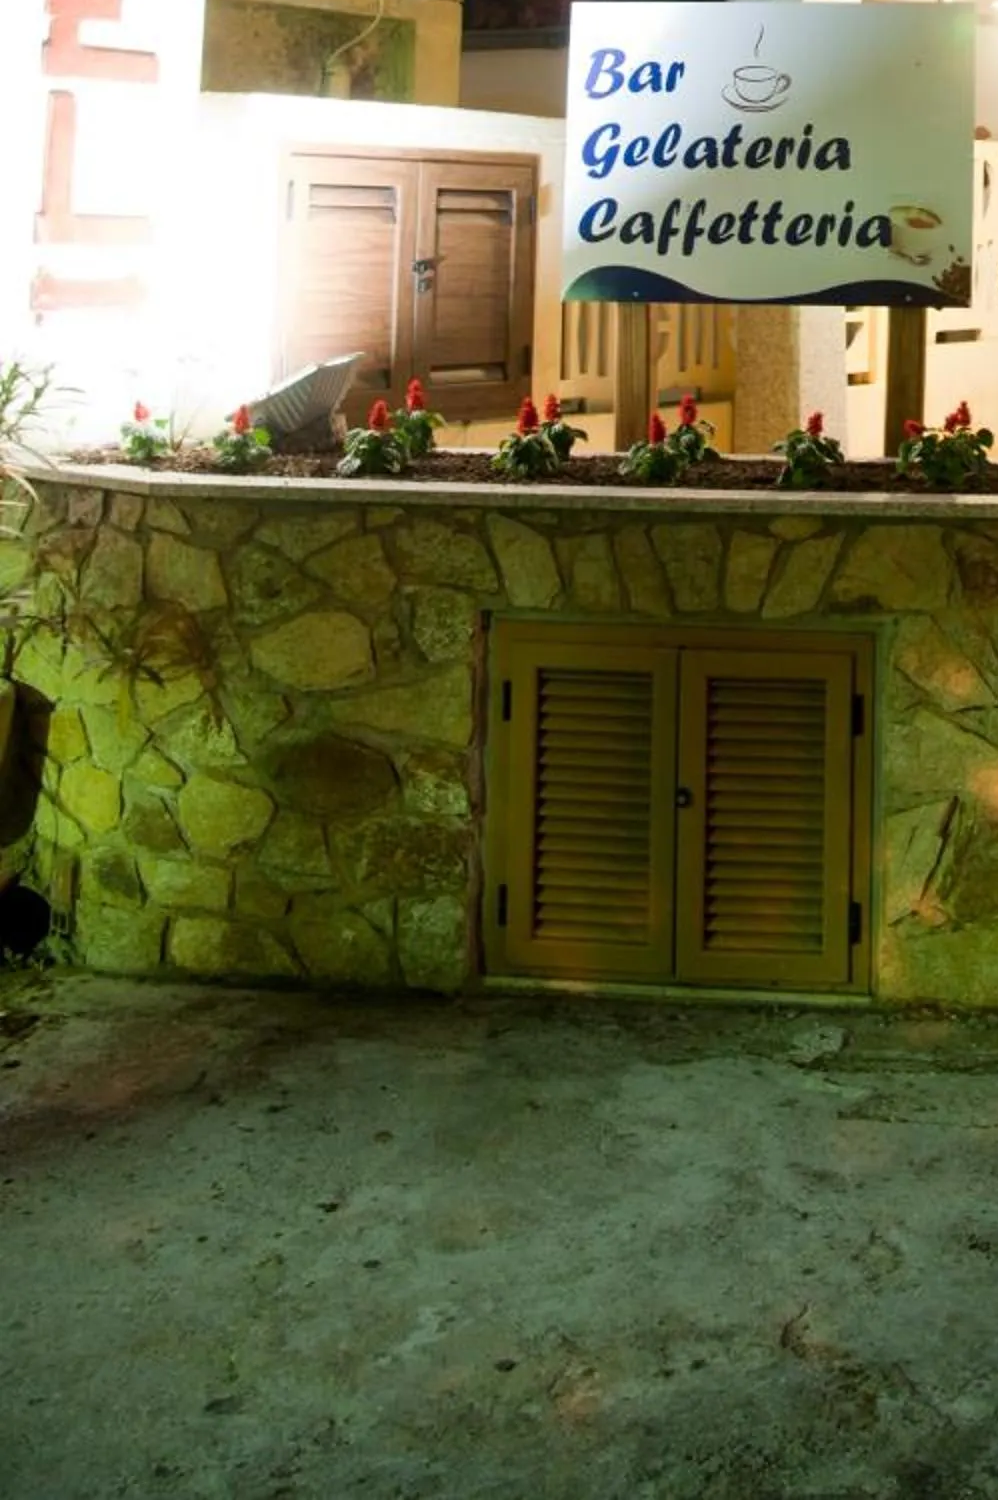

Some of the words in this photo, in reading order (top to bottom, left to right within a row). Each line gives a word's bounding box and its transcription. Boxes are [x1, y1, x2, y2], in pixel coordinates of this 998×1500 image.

[583, 47, 685, 100] Bar
[581, 122, 851, 179] Gelateria
[577, 197, 893, 257] Caffetteria
